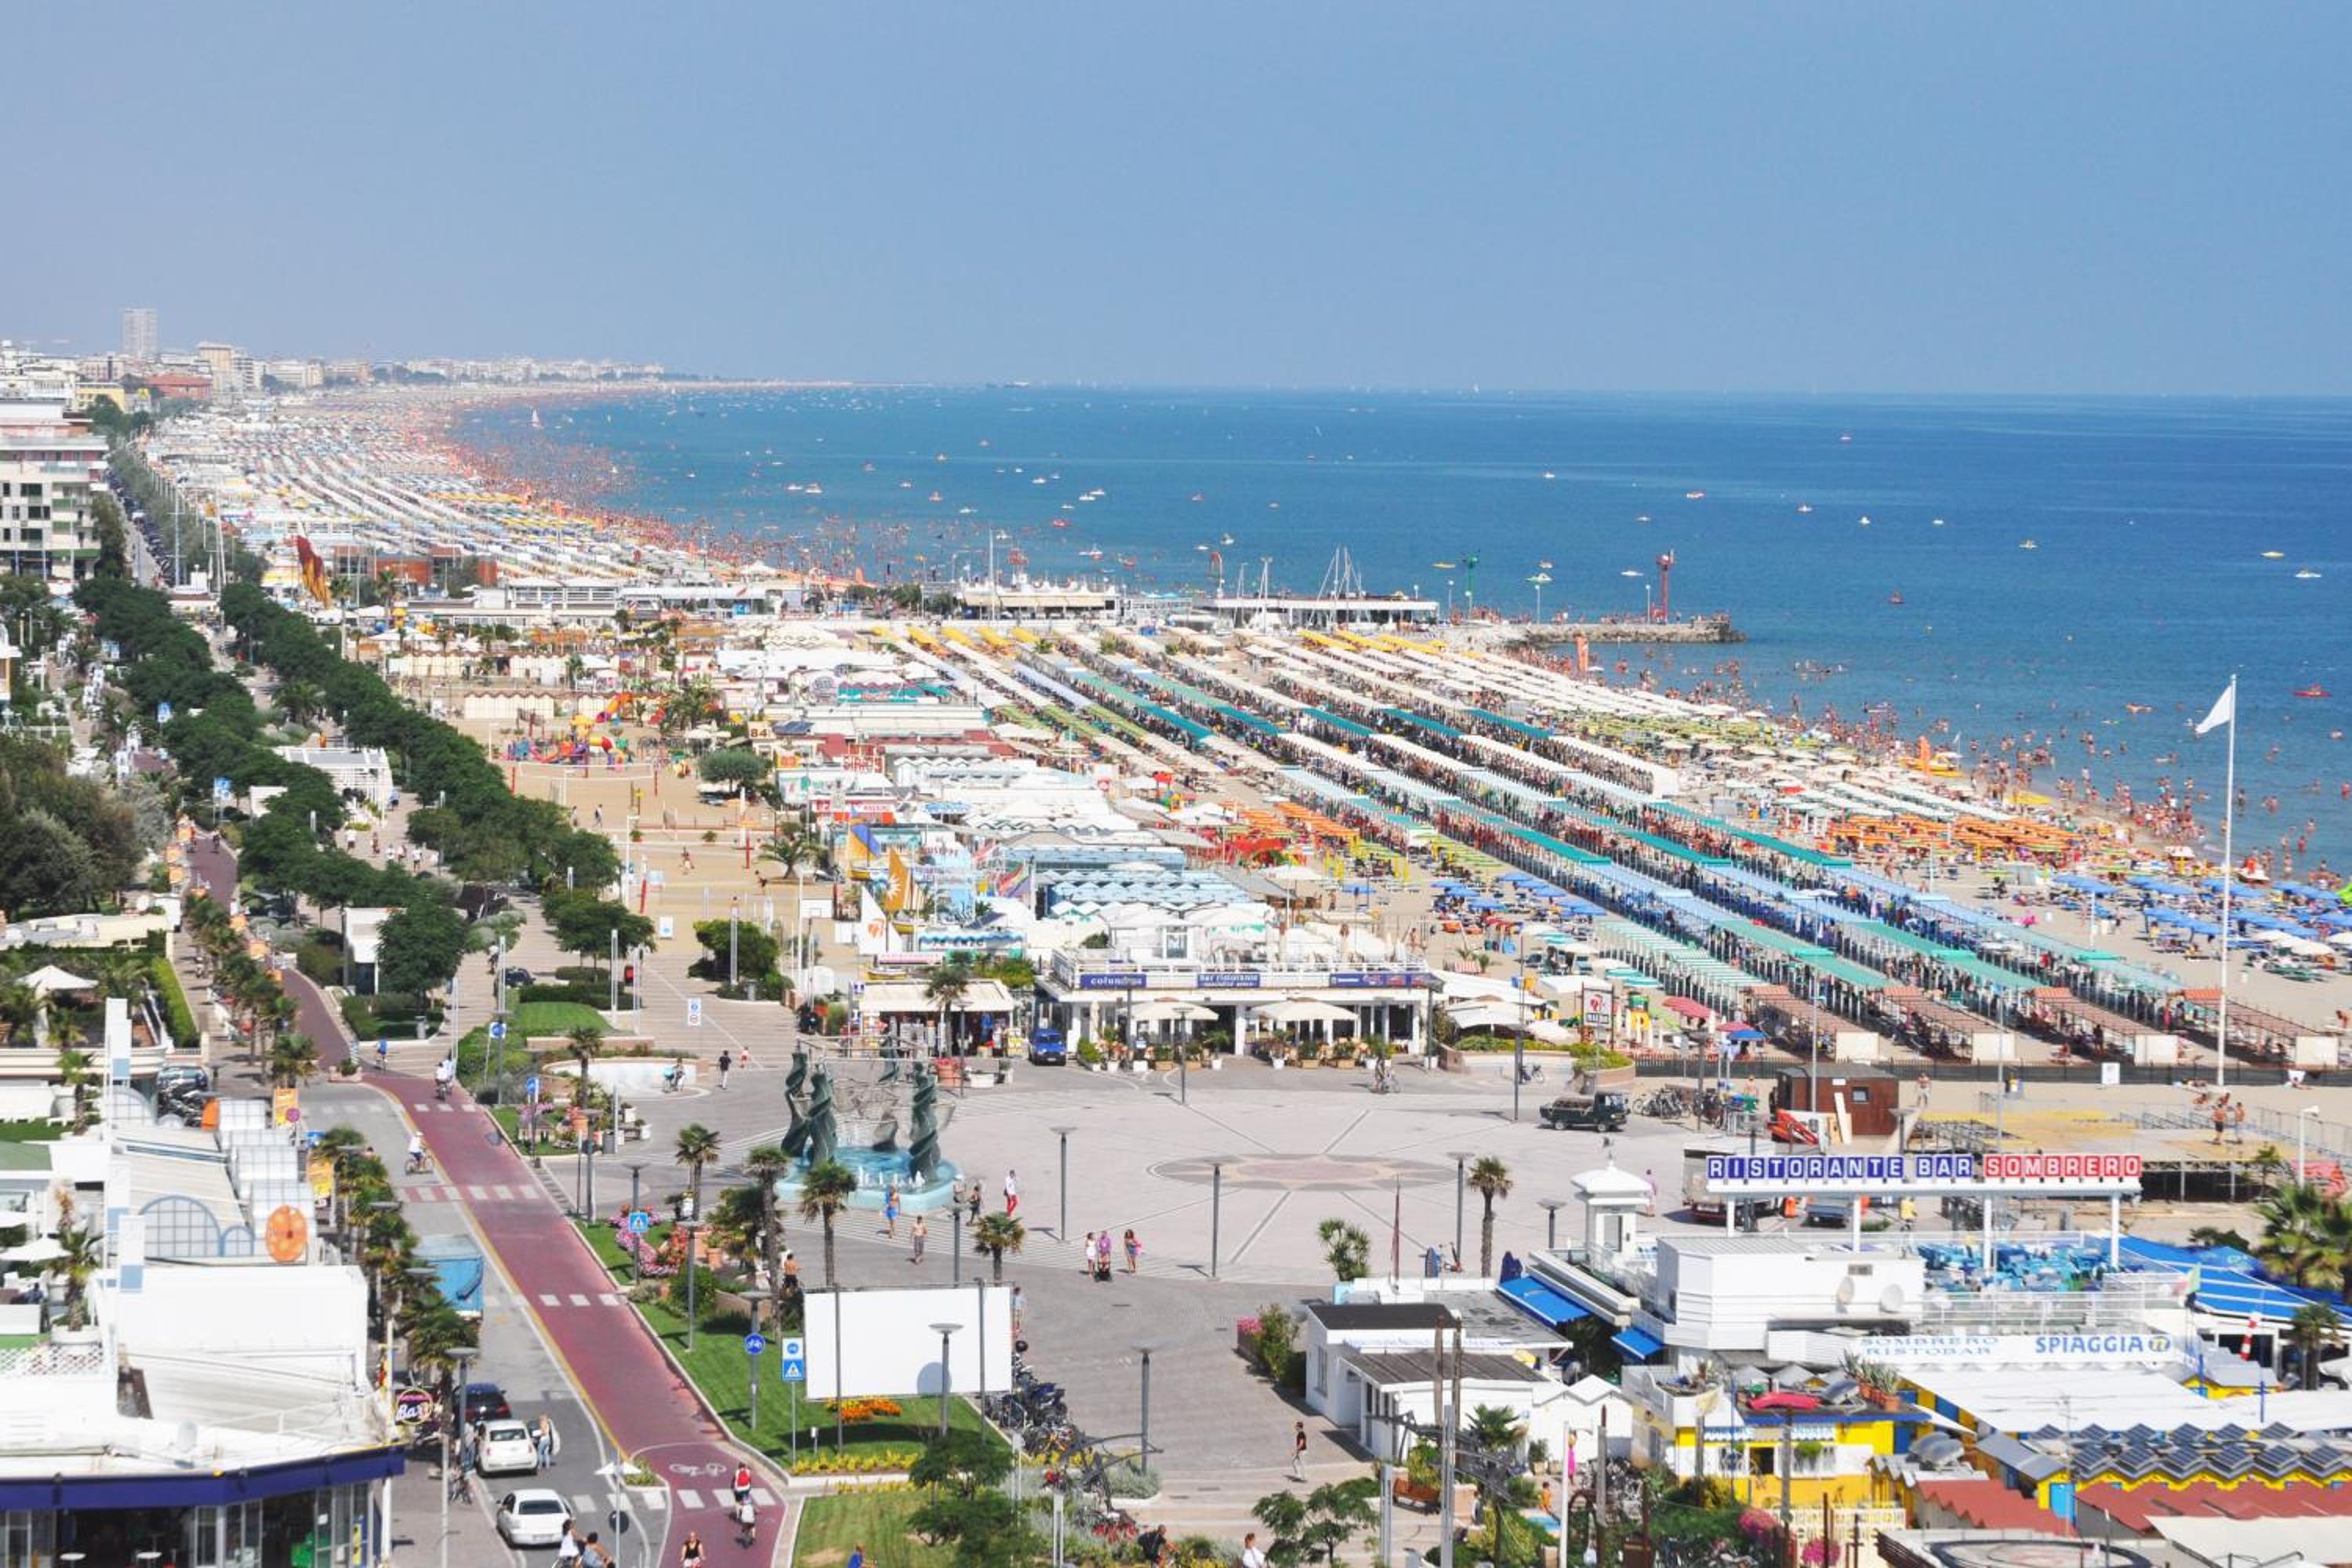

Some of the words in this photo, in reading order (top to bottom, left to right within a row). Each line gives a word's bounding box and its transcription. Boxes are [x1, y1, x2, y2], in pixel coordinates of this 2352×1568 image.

[1710, 1159, 1901, 1176] RISTORANTE
[1918, 1158, 1971, 1175] BAR
[1987, 1157, 2139, 1174] SOMBRERO
[2036, 1336, 2143, 1353] SPIAGGIA
